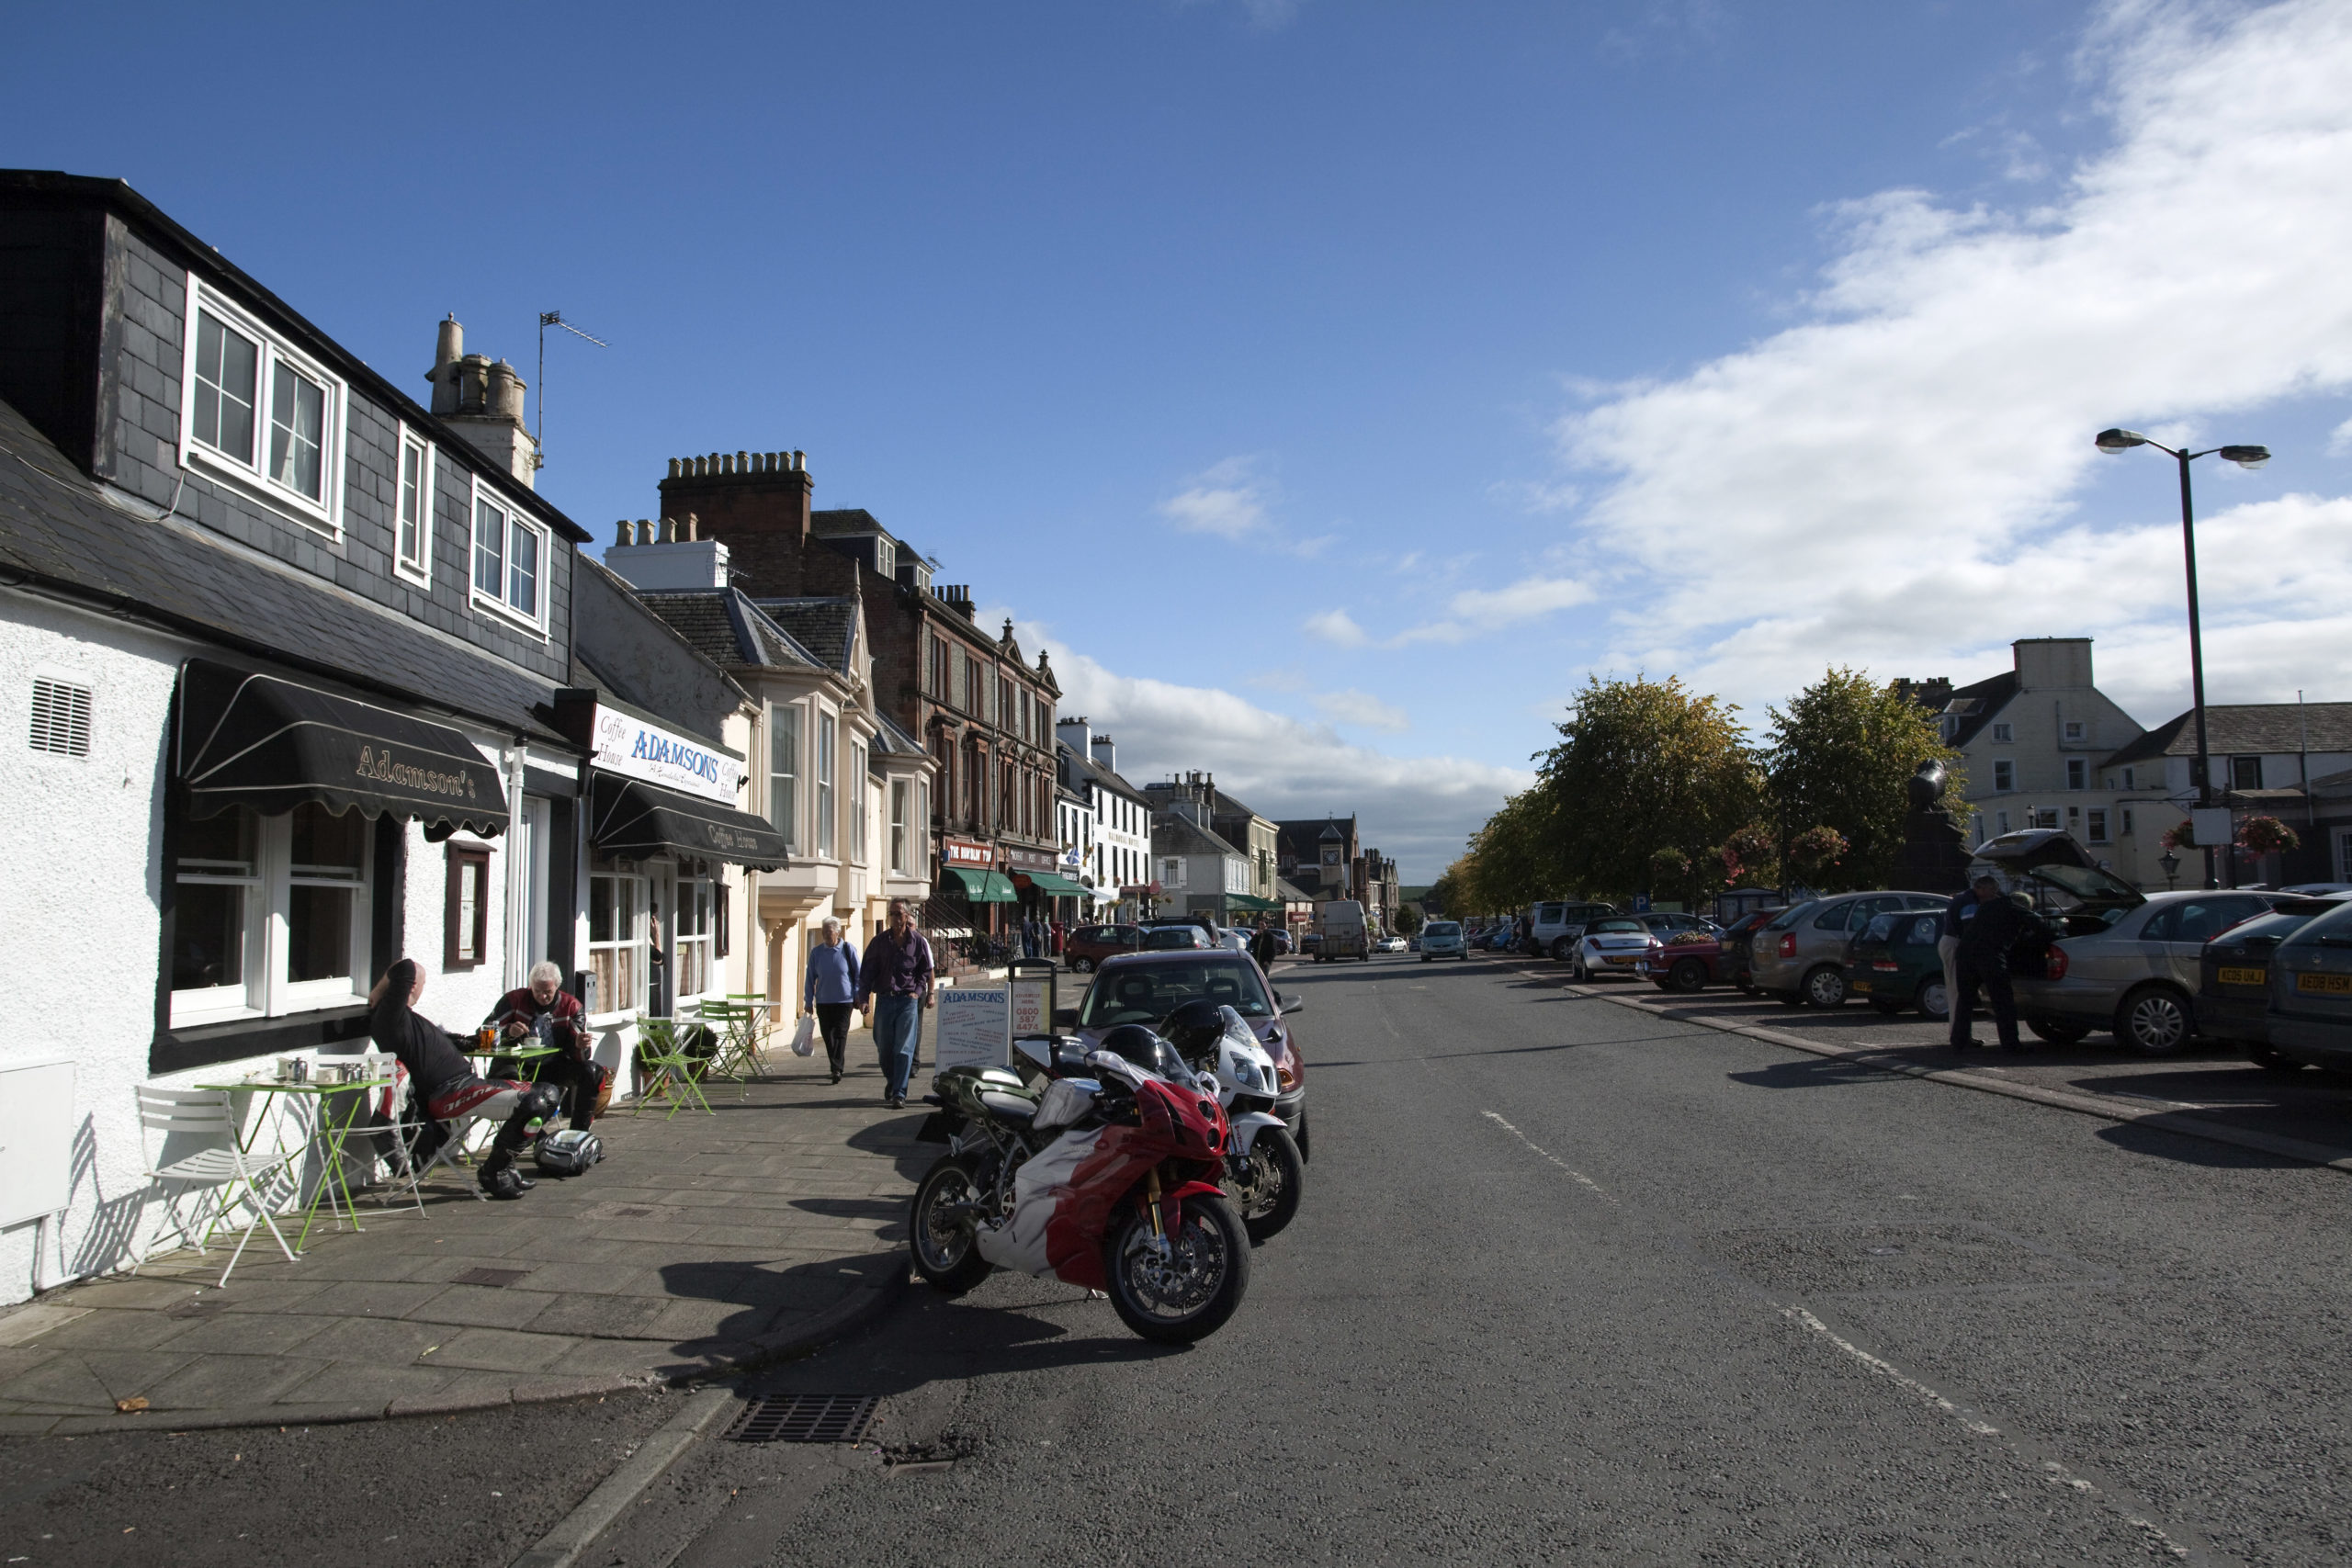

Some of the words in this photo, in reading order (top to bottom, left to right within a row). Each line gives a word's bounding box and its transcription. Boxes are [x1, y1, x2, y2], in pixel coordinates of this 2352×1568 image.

[600, 716, 627, 742] Coffee
[597, 743, 623, 766] House
[631, 729, 718, 784] ADAMSONS
[356, 745, 476, 798] Adamson's
[707, 824, 734, 850] Coffee
[734, 829, 758, 851] House
[949, 844, 959, 860] THE
[943, 993, 1004, 1003] ADAMSONS
[1019, 1015, 1036, 1023] 587
